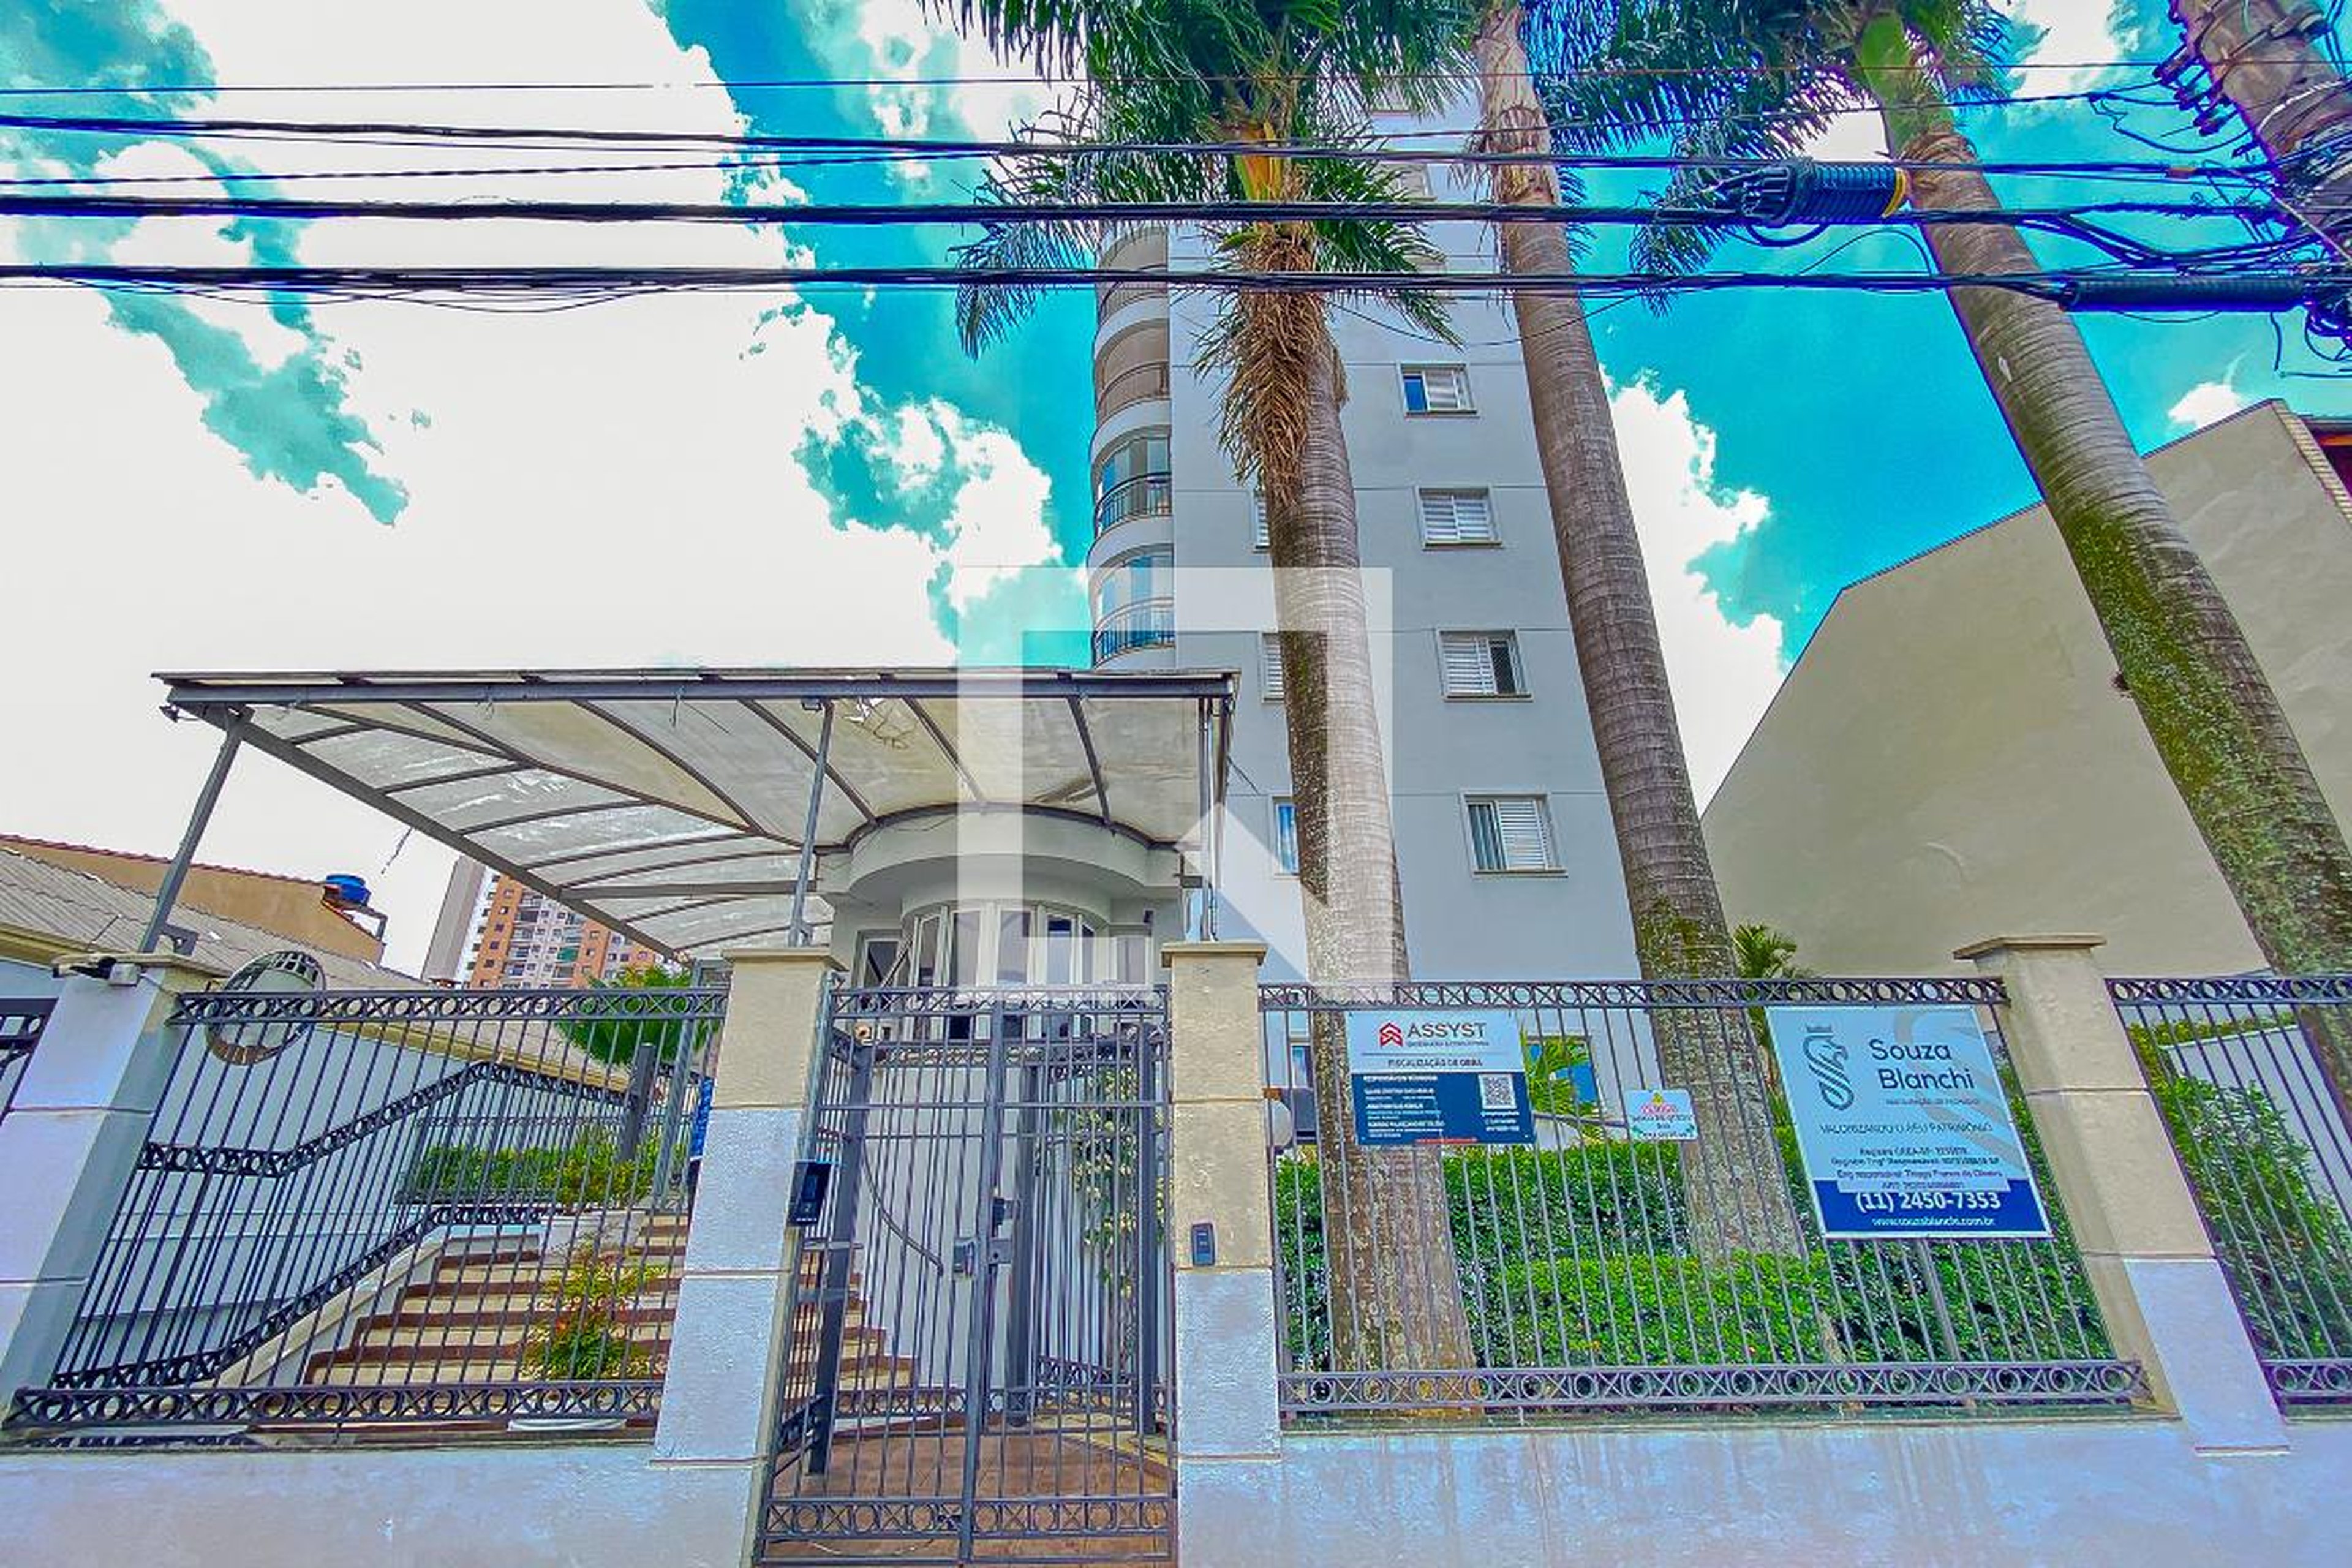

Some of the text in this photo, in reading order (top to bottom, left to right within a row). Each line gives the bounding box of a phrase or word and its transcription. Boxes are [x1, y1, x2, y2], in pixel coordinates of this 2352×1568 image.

[1407, 1023, 1487, 1038] ASSYST
[1869, 1038, 1952, 1060] Souza
[1856, 1191, 2001, 1213] (11) 2450-7353
